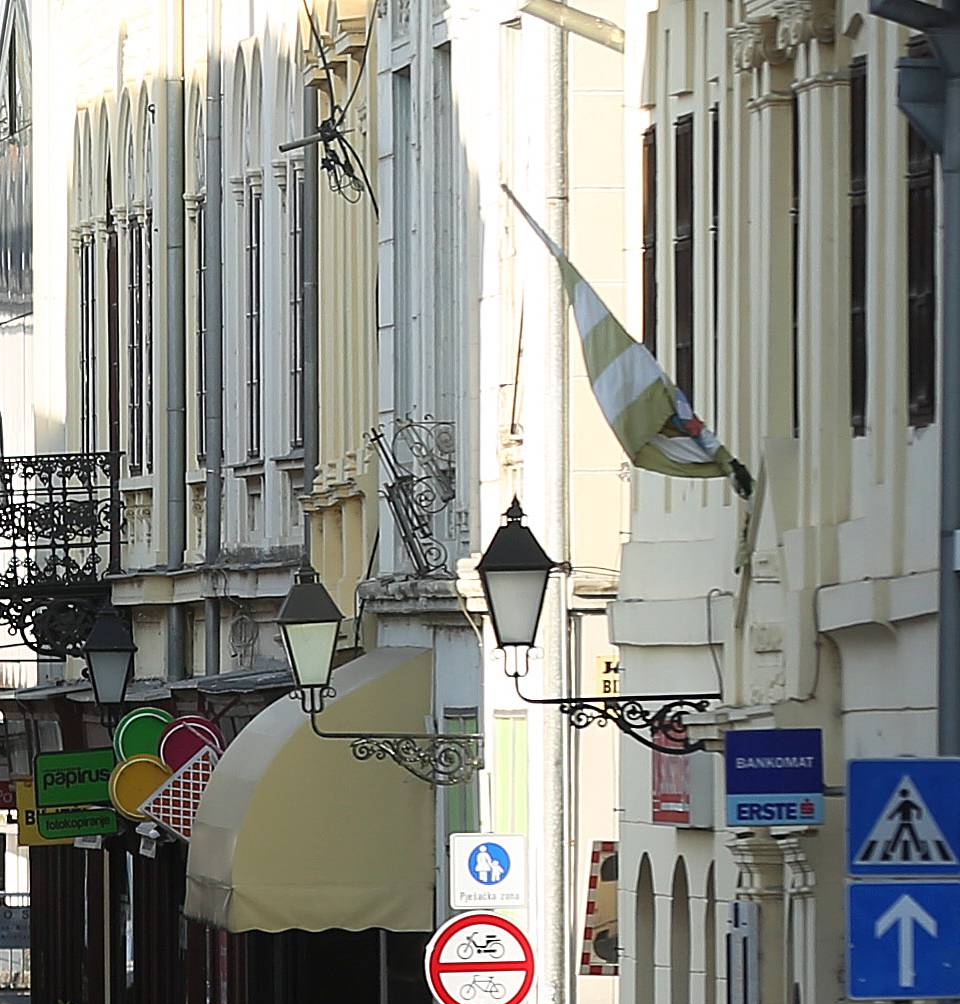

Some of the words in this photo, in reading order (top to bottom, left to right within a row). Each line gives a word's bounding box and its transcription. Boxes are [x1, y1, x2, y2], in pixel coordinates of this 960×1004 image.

[735, 756, 815, 769] BANKOMAT
[43, 766, 110, 791] papirus
[737, 802, 798, 822] ERSTE
